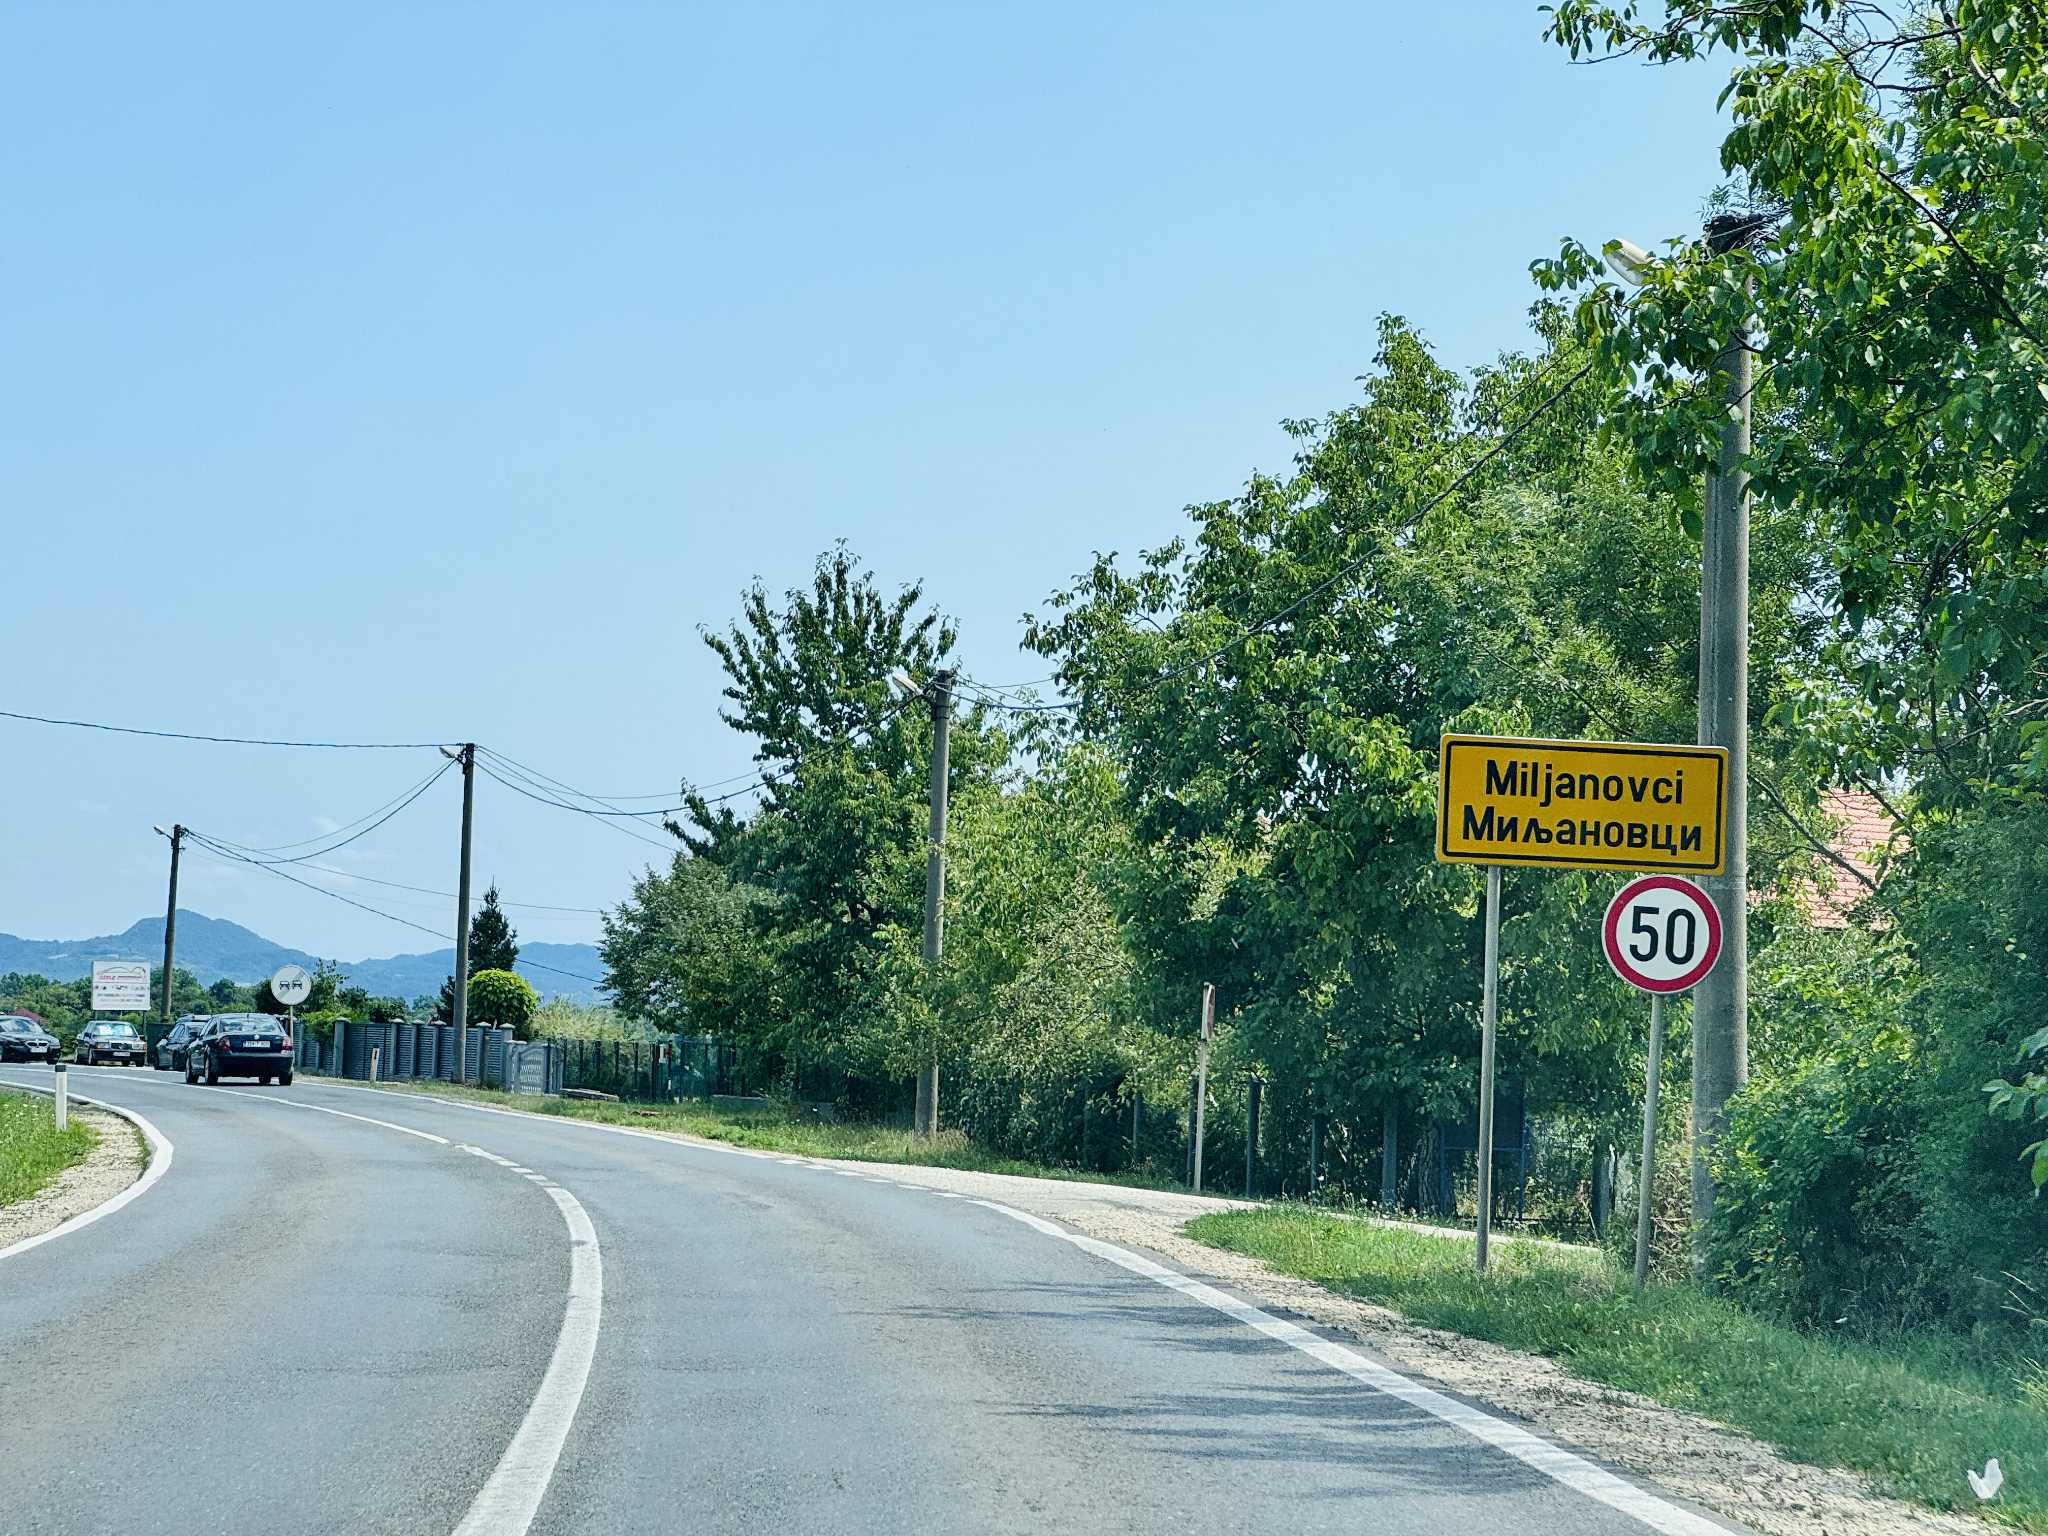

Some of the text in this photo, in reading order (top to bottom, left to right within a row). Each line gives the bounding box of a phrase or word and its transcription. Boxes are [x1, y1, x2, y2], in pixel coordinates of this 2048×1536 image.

[1485, 759, 1683, 807] Miljanovci
[1462, 805, 1701, 856] Миљановци
[1629, 905, 1696, 965] 50
